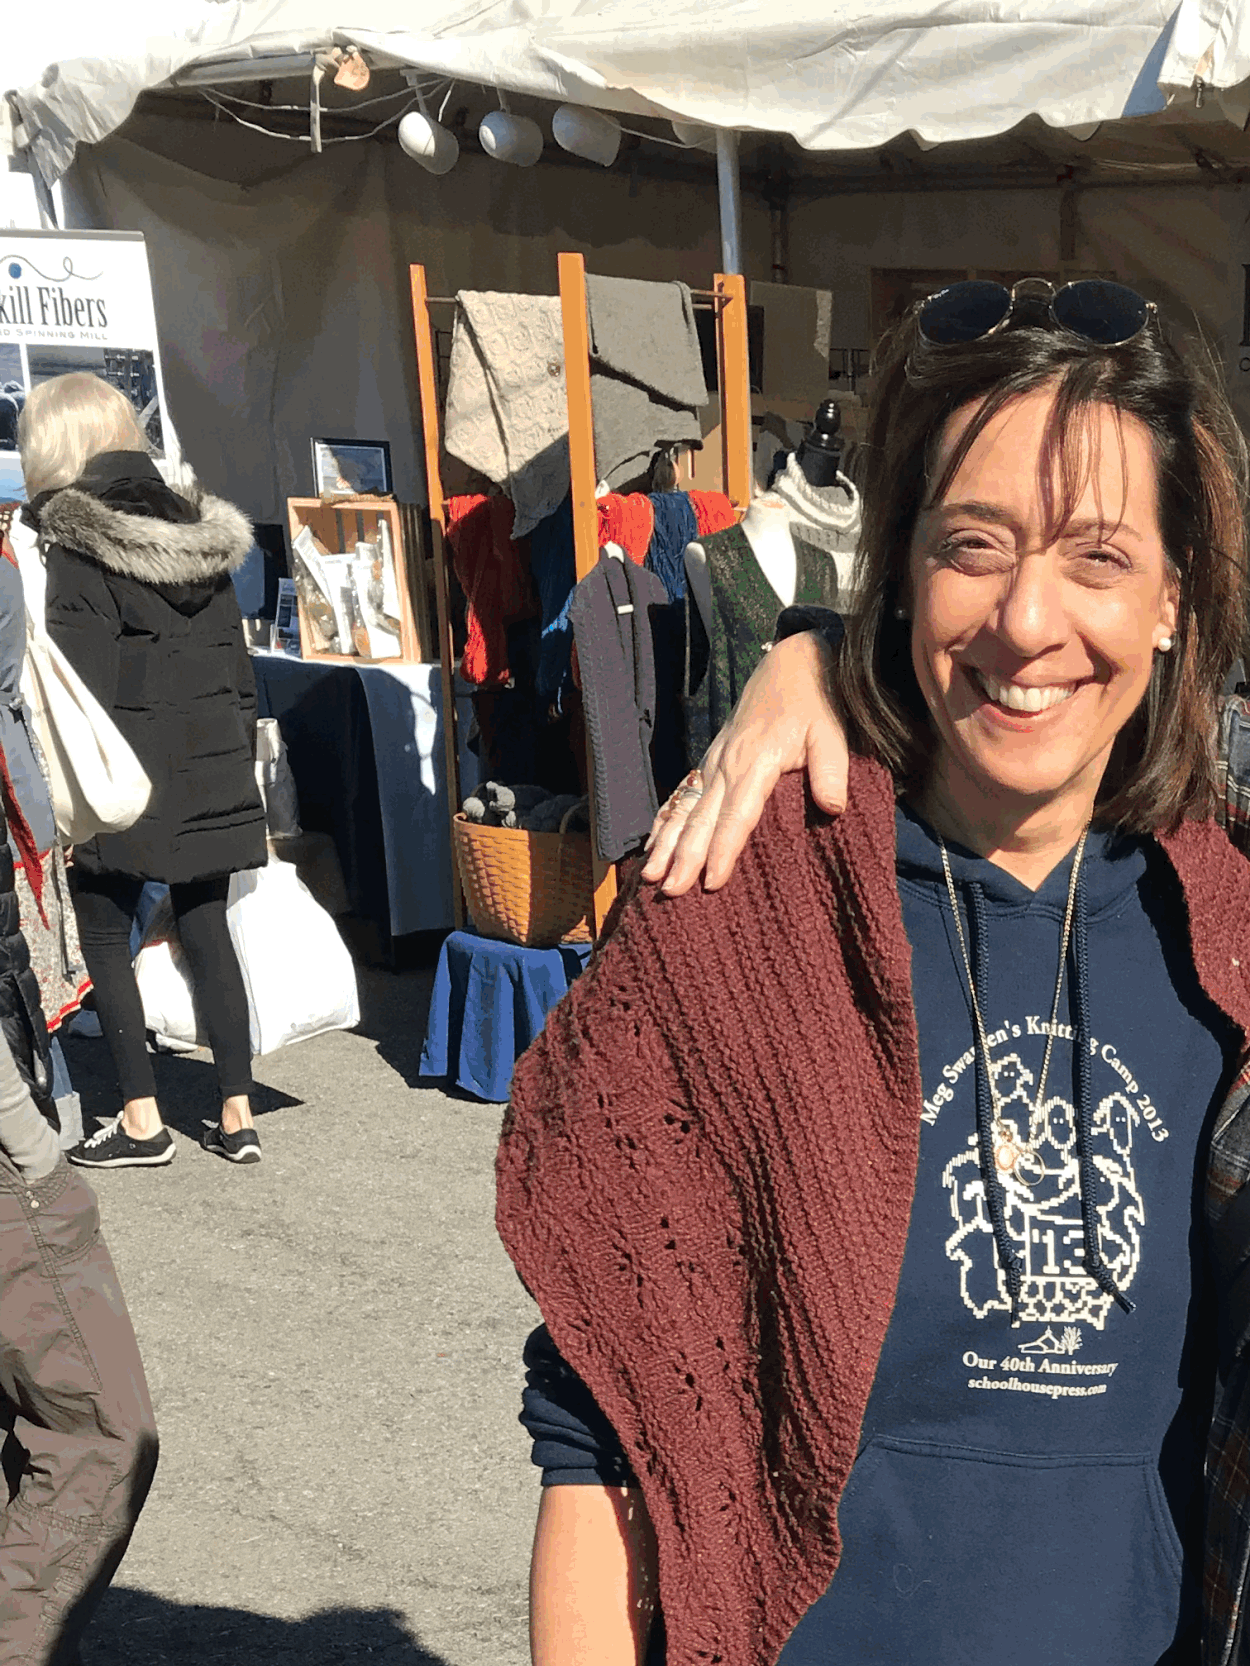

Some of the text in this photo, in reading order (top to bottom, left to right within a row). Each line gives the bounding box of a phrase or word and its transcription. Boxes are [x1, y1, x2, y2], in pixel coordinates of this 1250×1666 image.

[36, 286, 108, 328] Fibers
[16, 329, 75, 339] SPINNING
[80, 331, 108, 340] MILL
[920, 1083, 954, 1126] Meg
[1101, 1044, 1139, 1095] Camp
[1136, 1094, 1169, 1143] 2013
[962, 1351, 1119, 1377] Our 40th Anniversary
[968, 1376, 1107, 1399] schoolhousepress.com
